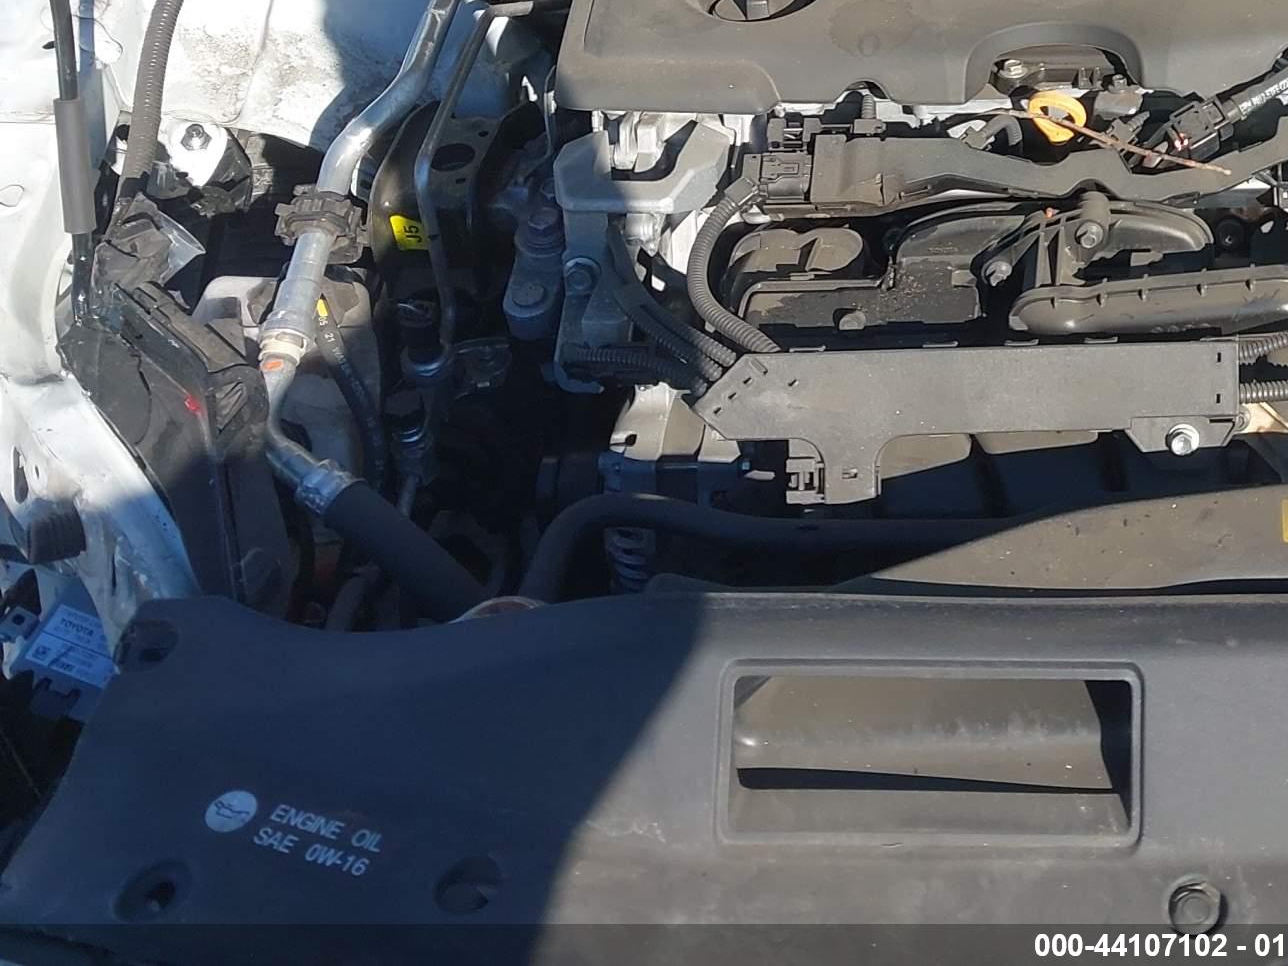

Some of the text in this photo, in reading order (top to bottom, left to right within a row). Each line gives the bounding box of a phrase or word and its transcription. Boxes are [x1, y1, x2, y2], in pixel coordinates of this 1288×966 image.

[403, 225, 423, 243] J5
[324, 332, 336, 343] 21
[60, 618, 95, 637] TOYOTA
[270, 803, 384, 853] ENGINE OIL
[253, 827, 370, 877] SAE 0W-16
